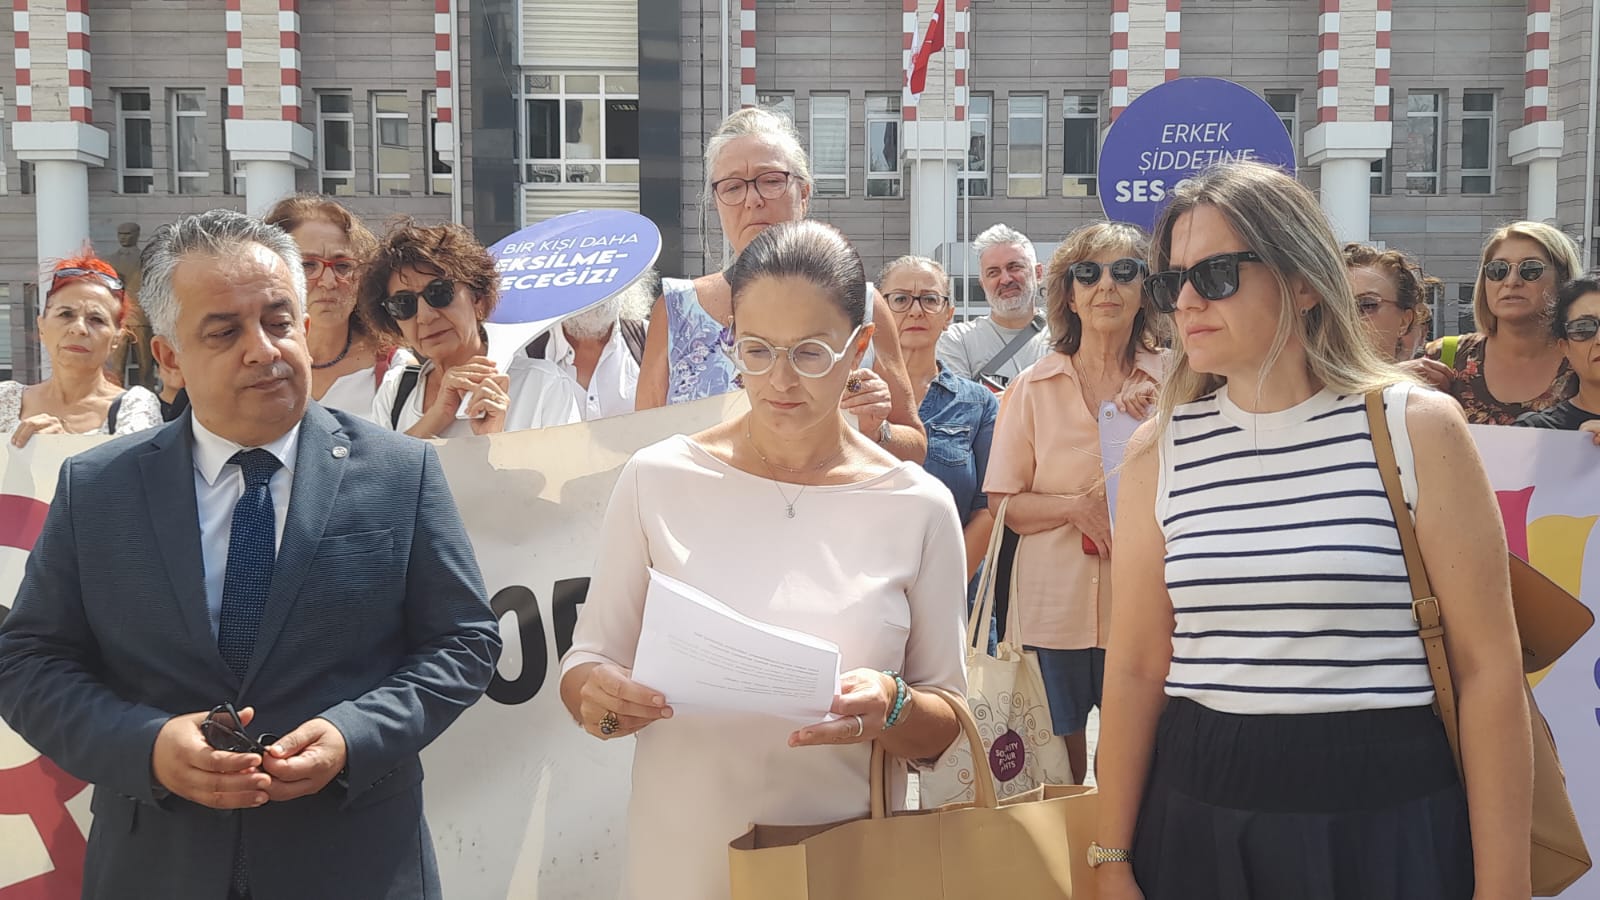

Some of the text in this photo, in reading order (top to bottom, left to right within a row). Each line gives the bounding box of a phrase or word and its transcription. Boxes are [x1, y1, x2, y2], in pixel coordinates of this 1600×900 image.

[1161, 122, 1232, 143] ERKEK
[1115, 179, 1165, 203] SES
[502, 240, 536, 255] BİR
[580, 233, 638, 249] DAHA
[495, 249, 628, 273] EKSİLME-
